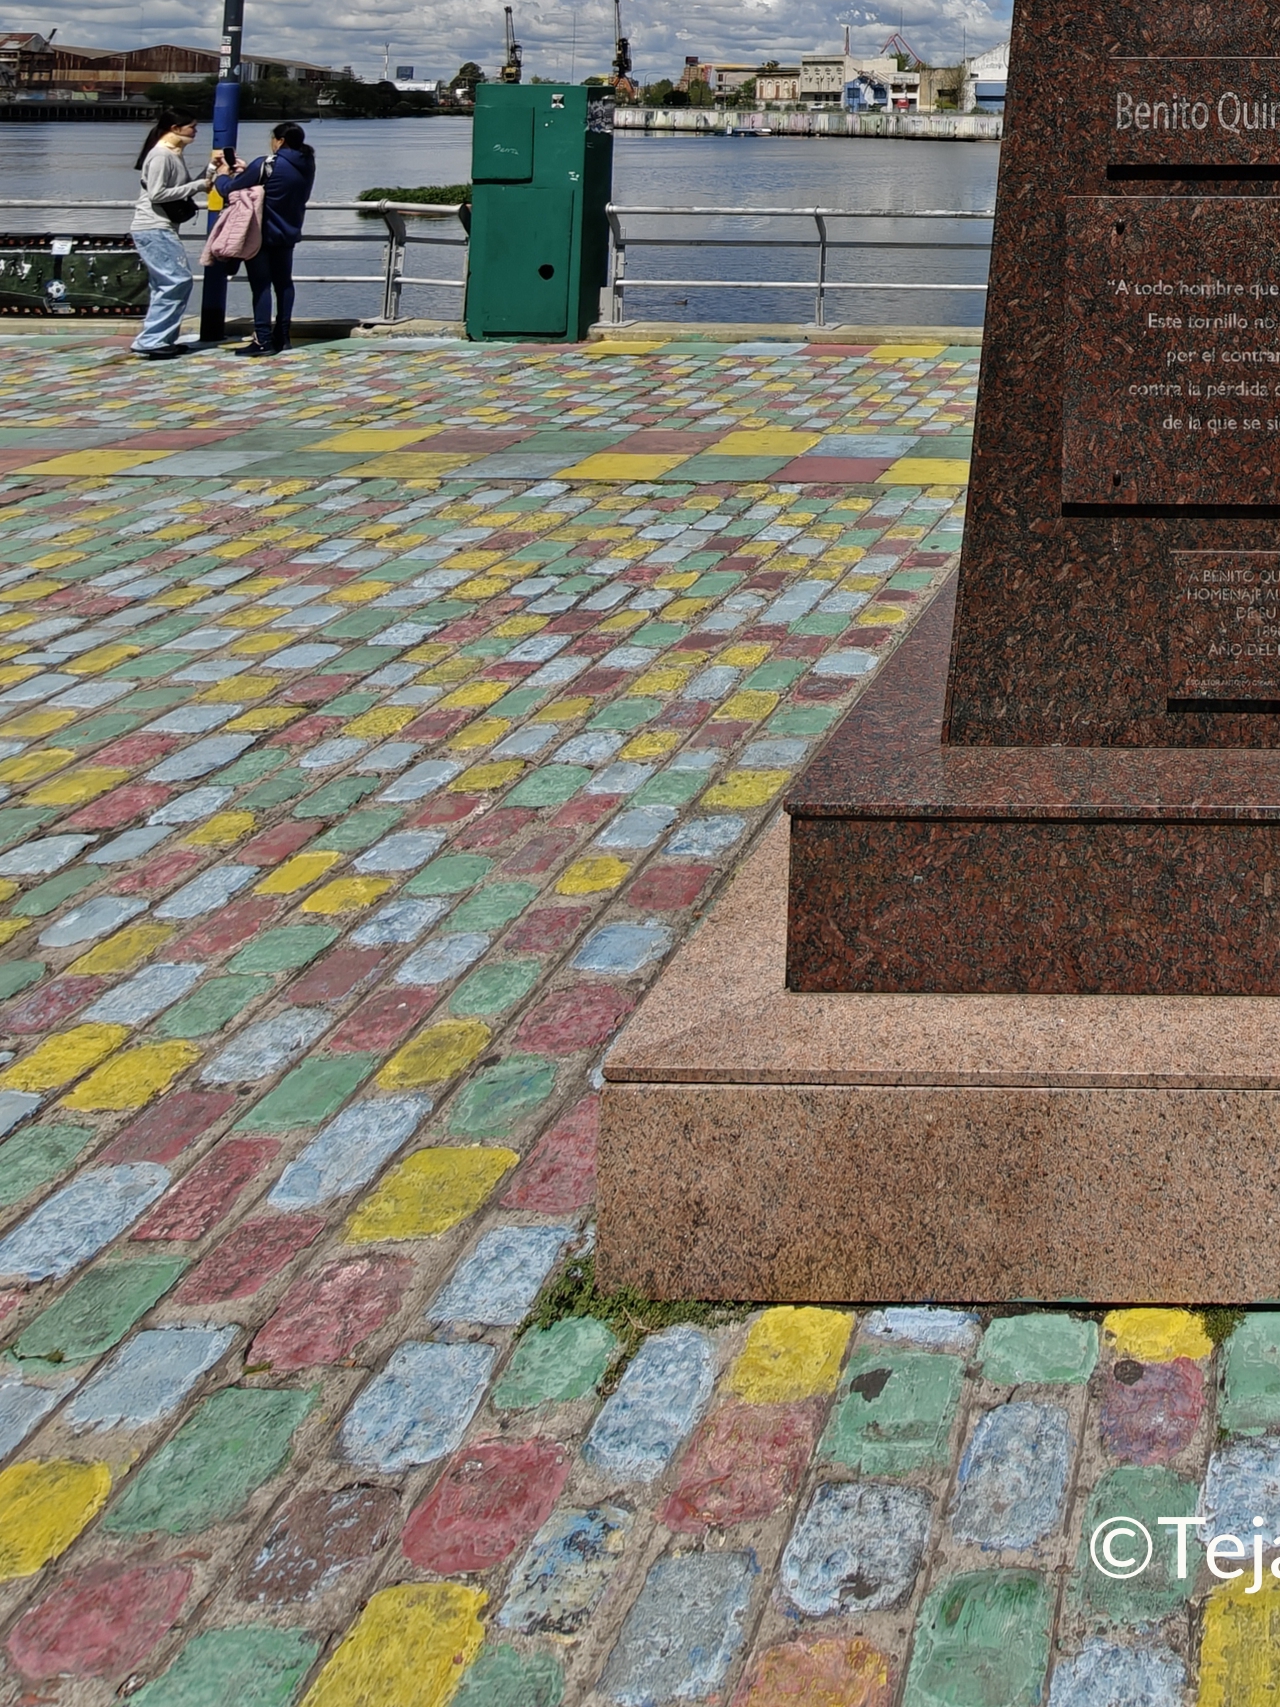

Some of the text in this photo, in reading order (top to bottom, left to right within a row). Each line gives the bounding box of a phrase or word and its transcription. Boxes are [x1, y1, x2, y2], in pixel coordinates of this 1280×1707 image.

[1116, 92, 1209, 130] Benito
[1135, 279, 1173, 295] todo
[1180, 279, 1244, 295] hombre
[1250, 285, 1279, 300] que
[1149, 313, 1182, 328] Este
[1188, 313, 1248, 328] tornillo
[1254, 319, 1275, 329] no
[1166, 351, 1196, 366] por
[1201, 347, 1215, 362] el
[1128, 383, 1182, 396] contra
[1188, 380, 1201, 396] la
[1207, 380, 1269, 399] pérdida
[1163, 414, 1182, 430] de
[1188, 414, 1201, 430] la
[1207, 418, 1238, 434] que
[1243, 419, 1261, 430] se
[1188, 570, 1199, 583] A
[1203, 569, 1255, 583] BENITO
[1187, 588, 1261, 604] HOMENAJE
[1236, 606, 1256, 620] DE
[1259, 606, 1276, 620] SU
[1247, 643, 1275, 656] DEL
